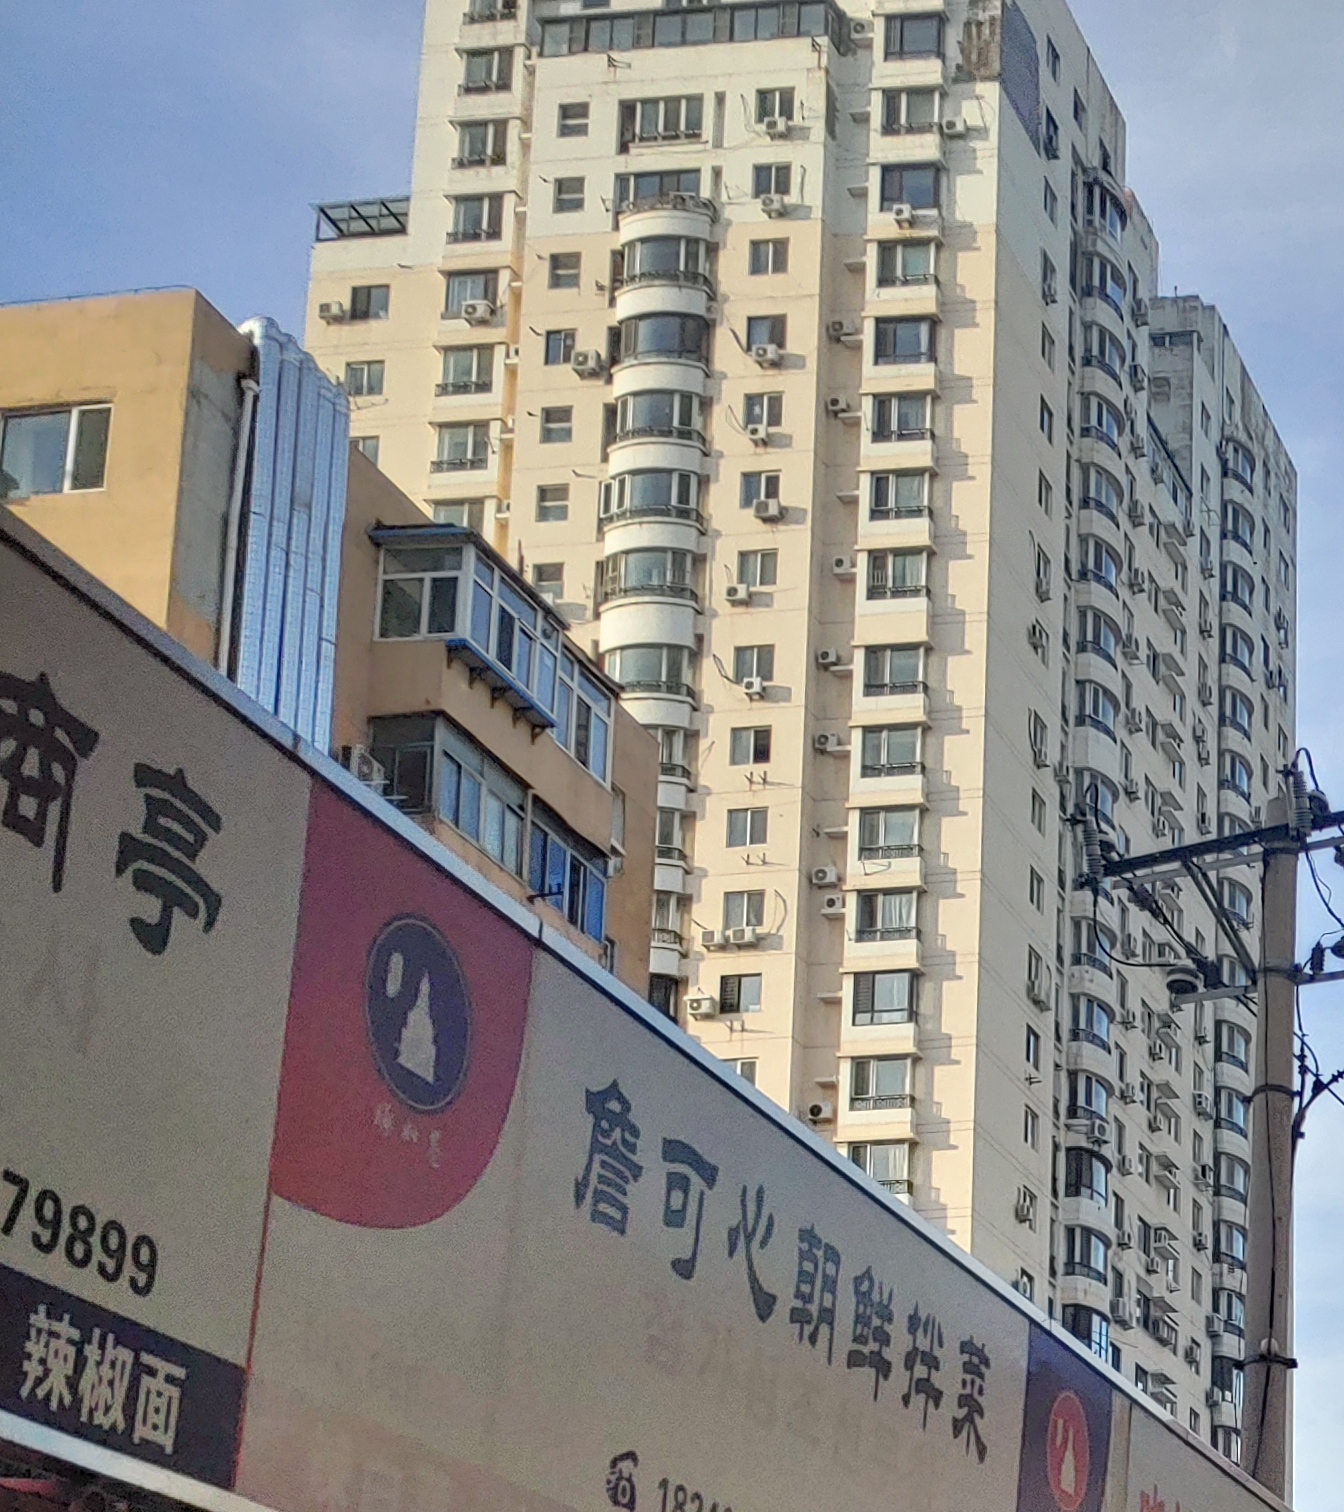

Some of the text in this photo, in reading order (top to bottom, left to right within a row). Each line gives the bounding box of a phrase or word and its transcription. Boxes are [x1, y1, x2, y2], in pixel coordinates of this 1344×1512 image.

[1, 1167, 159, 1298] 79899
[19, 1303, 187, 1456] 辣椒面
